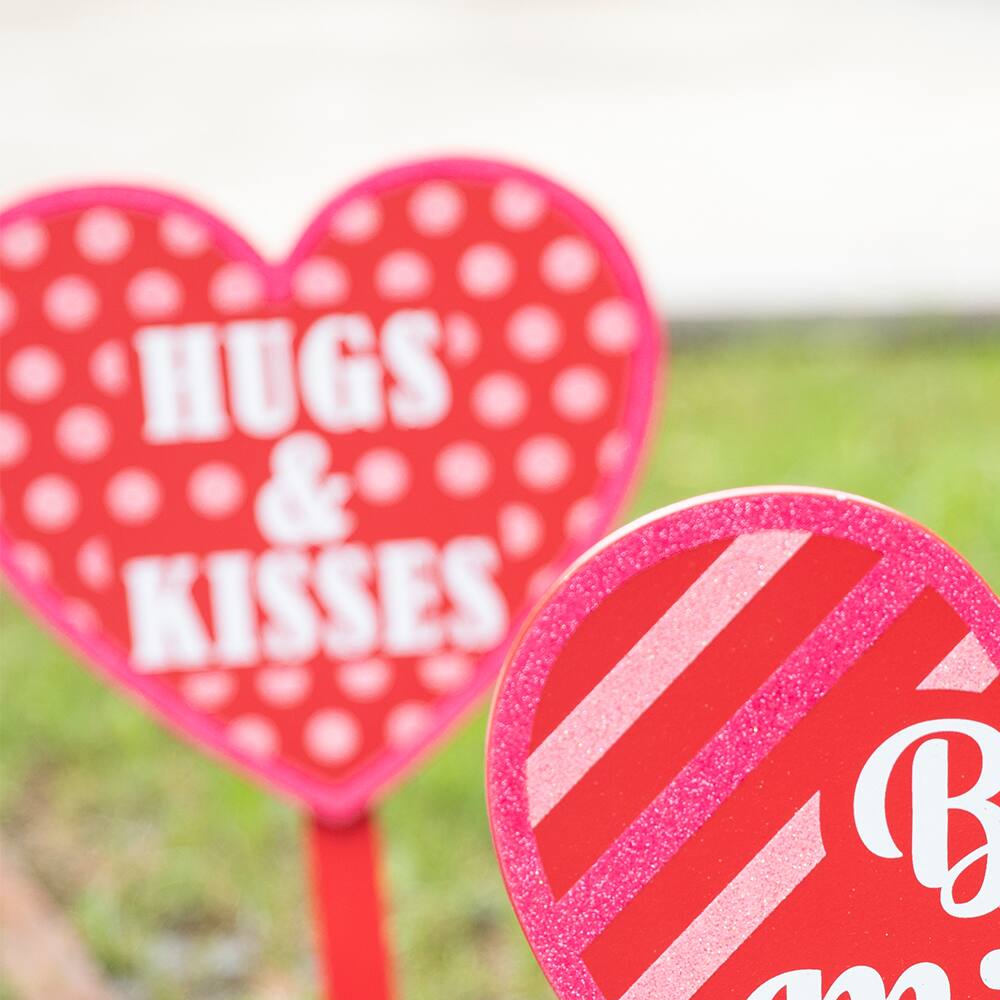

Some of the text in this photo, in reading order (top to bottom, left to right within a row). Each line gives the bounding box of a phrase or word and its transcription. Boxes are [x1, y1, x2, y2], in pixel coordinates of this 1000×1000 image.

[134, 310, 452, 445] HUGS
[255, 431, 355, 547] &
[124, 535, 509, 674] KISSES
